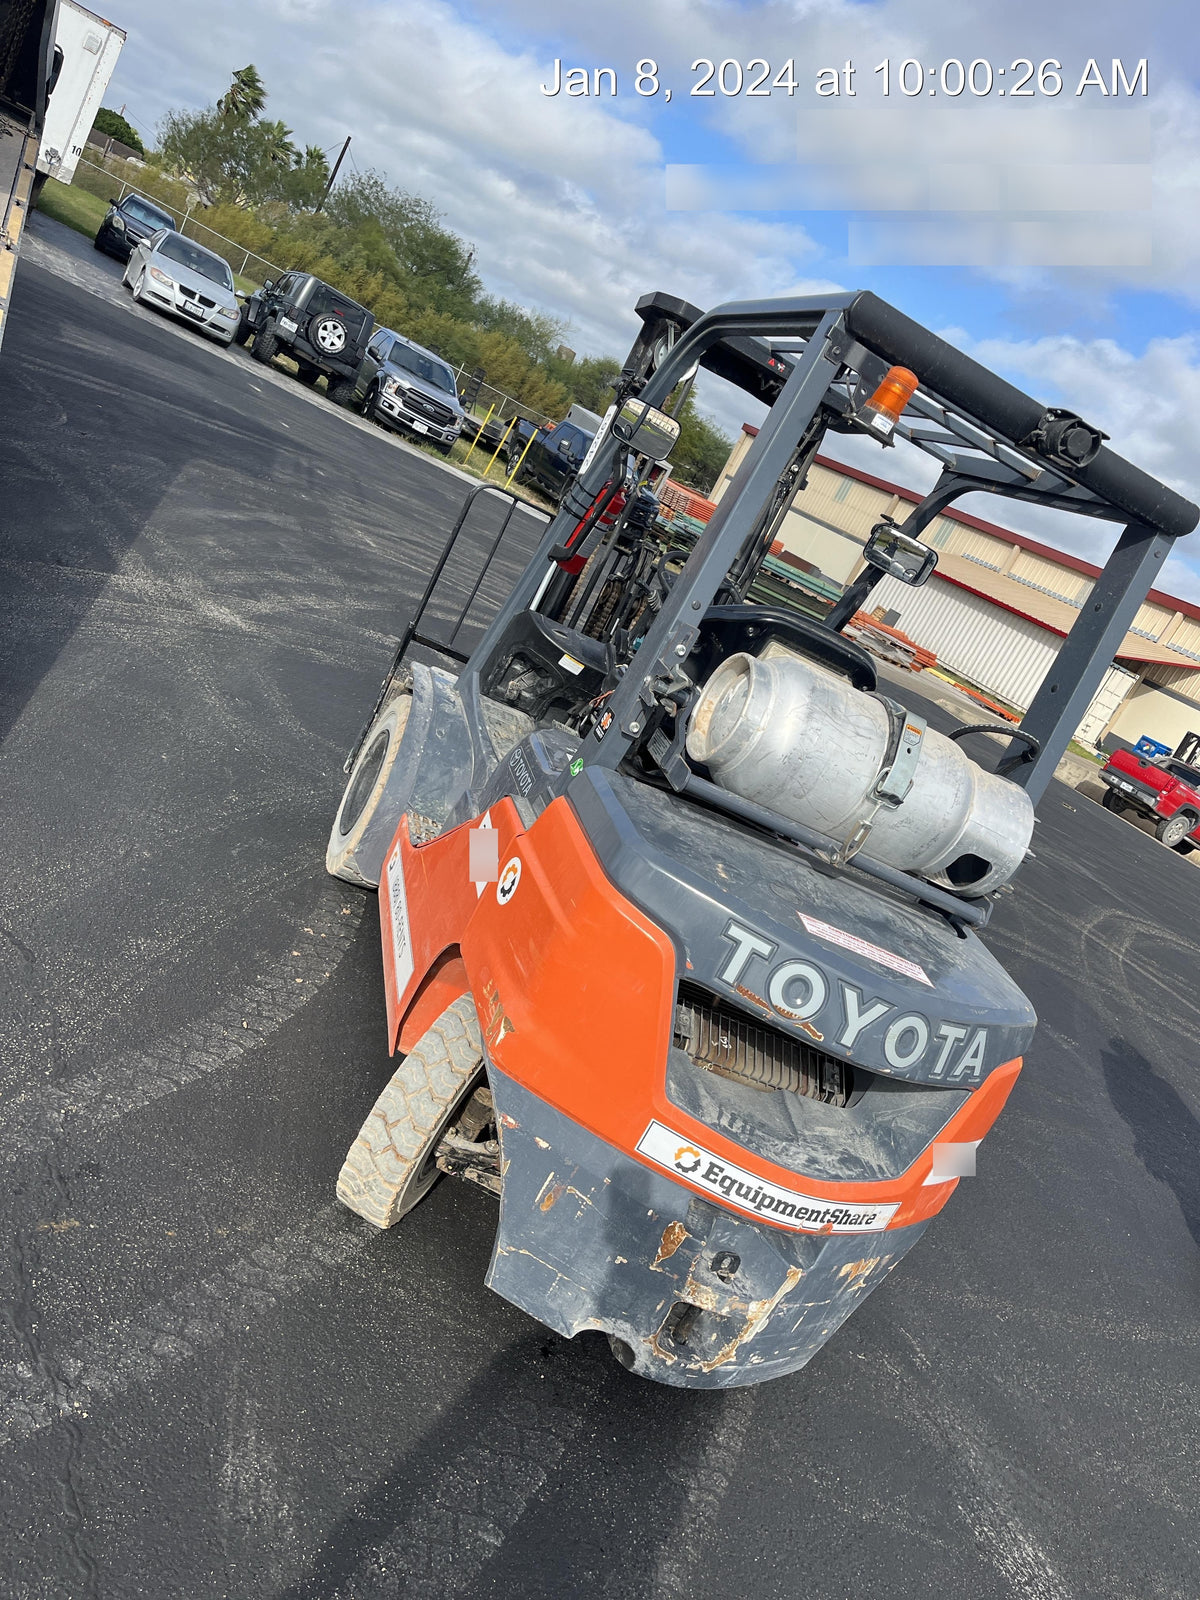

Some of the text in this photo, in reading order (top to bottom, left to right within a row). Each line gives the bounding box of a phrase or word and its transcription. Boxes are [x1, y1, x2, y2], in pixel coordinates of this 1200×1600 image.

[515, 758, 533, 797] TOYOTA
[721, 922, 988, 1077] TOYOTA
[701, 1161, 877, 1226] EquipmentShare
